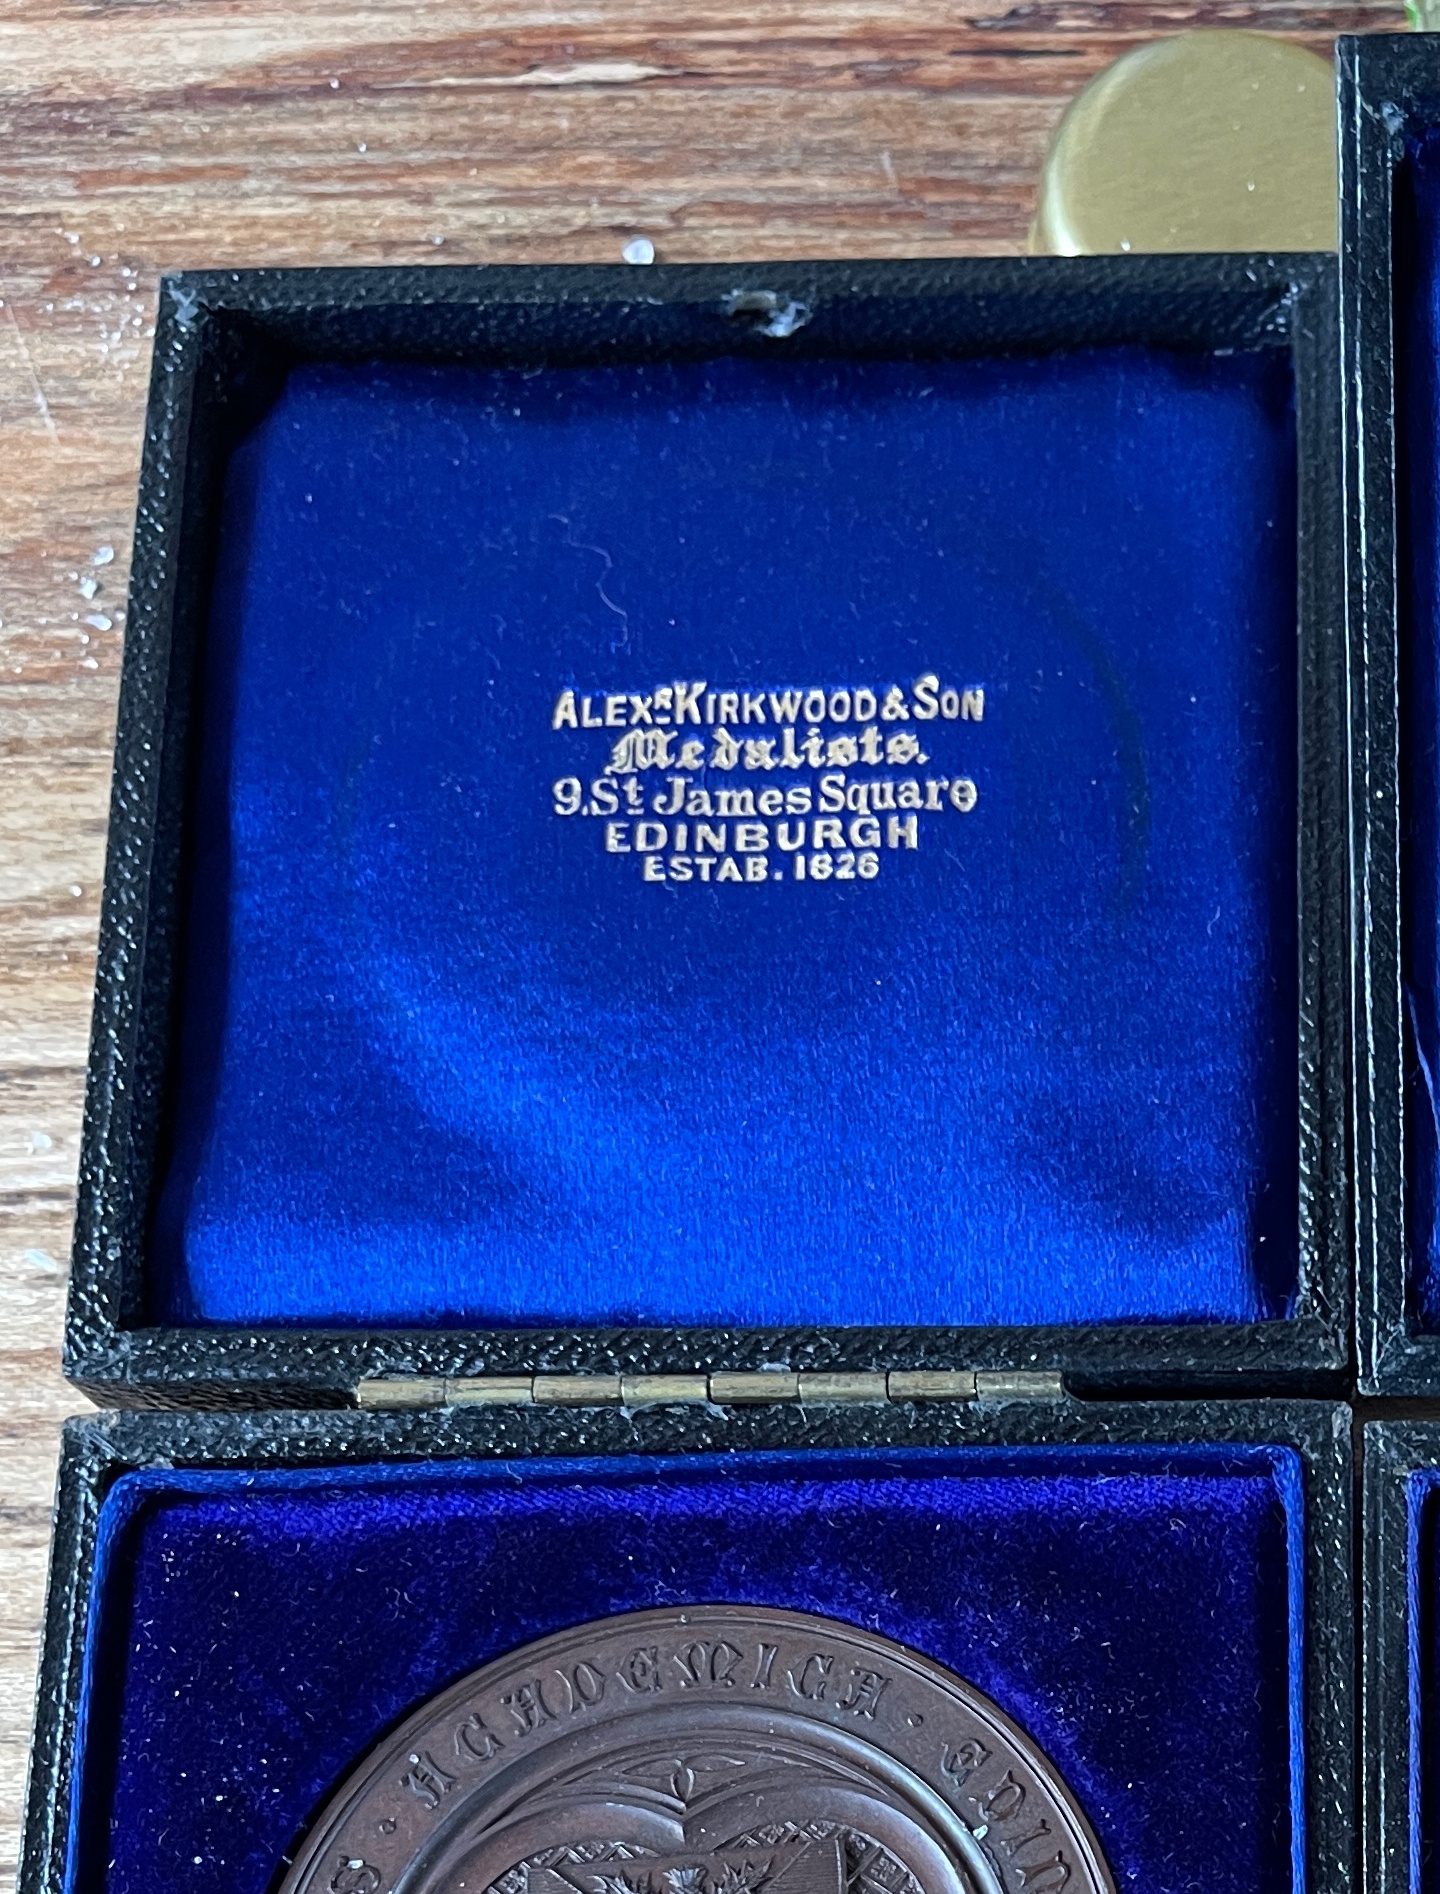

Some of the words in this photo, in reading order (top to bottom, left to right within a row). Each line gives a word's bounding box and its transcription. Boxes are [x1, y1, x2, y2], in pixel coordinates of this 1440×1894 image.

[673, 681, 876, 726] KIRKWOOD
[881, 686, 910, 722] &
[652, 776, 813, 818] James
[818, 772, 979, 816] Square
[604, 816, 919, 854] EDINBURGH
[401, 1640, 893, 1811] ACADEMICA
